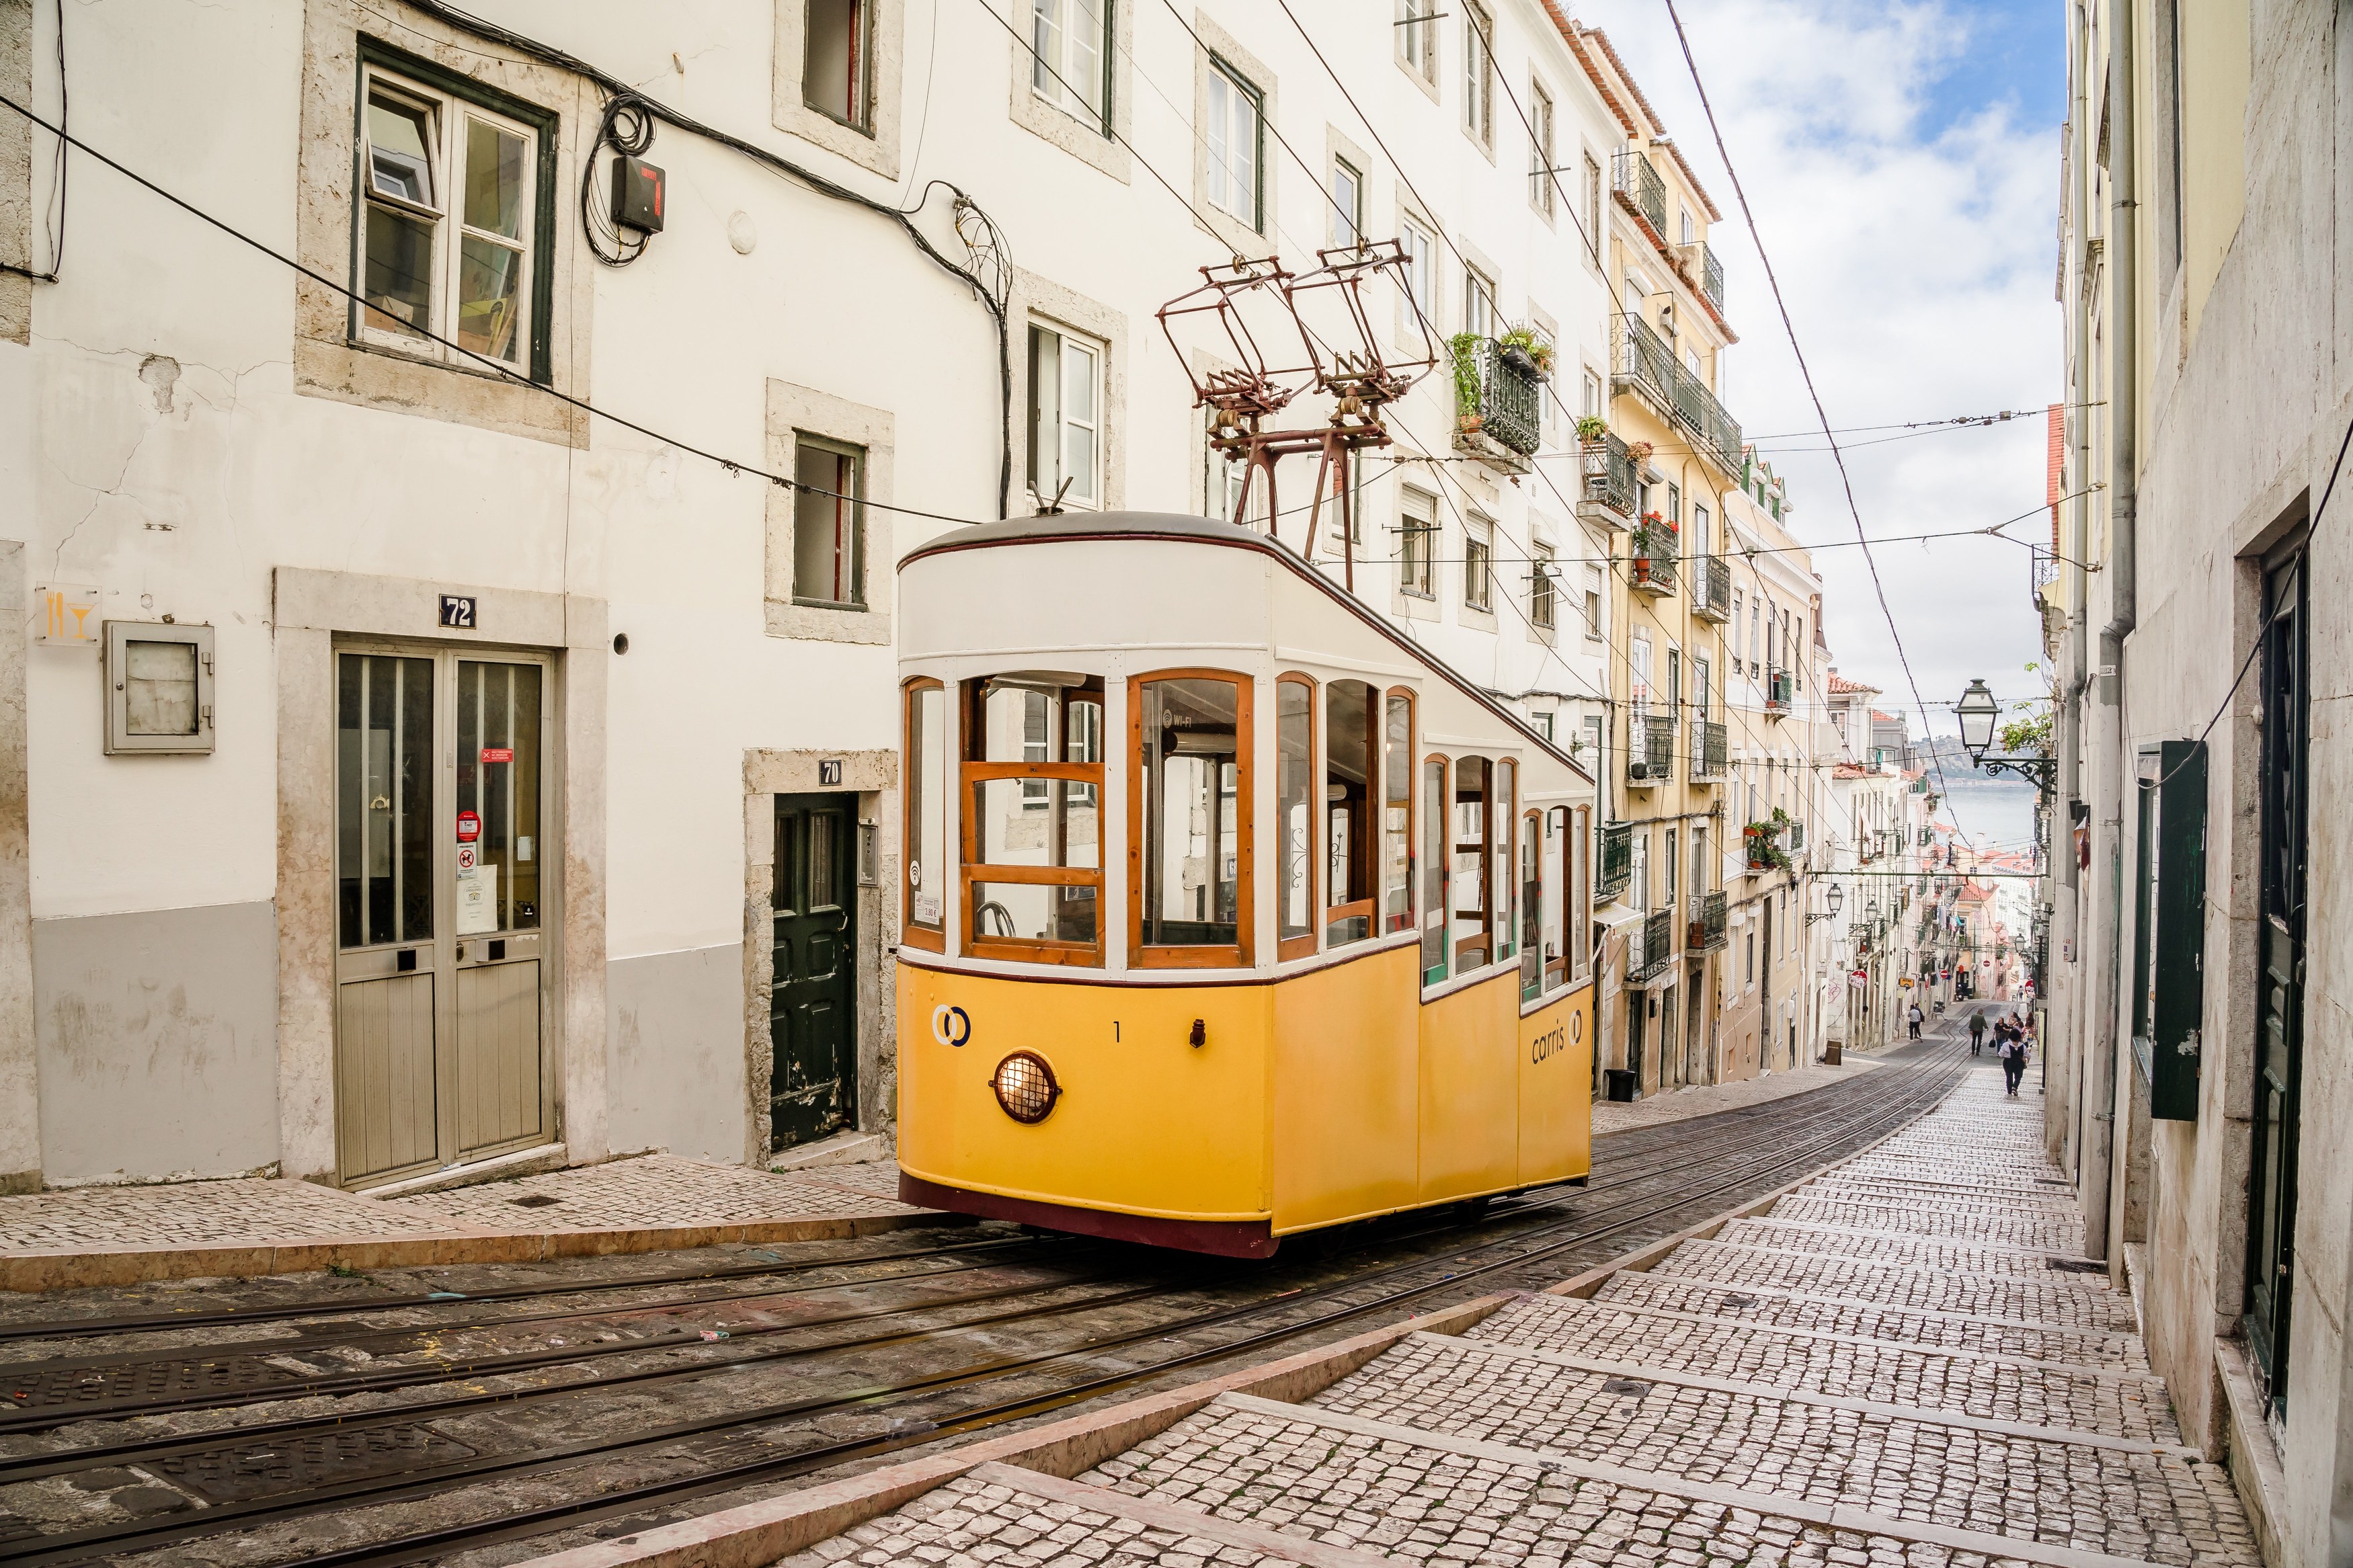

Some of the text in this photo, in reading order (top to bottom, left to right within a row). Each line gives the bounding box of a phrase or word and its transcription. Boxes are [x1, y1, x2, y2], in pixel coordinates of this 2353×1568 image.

[446, 598, 471, 626] 72
[1174, 714, 1192, 728] WI-FI
[824, 762, 839, 784] 70
[1113, 1021, 1120, 1043] 1
[1532, 1018, 1564, 1065] carris
